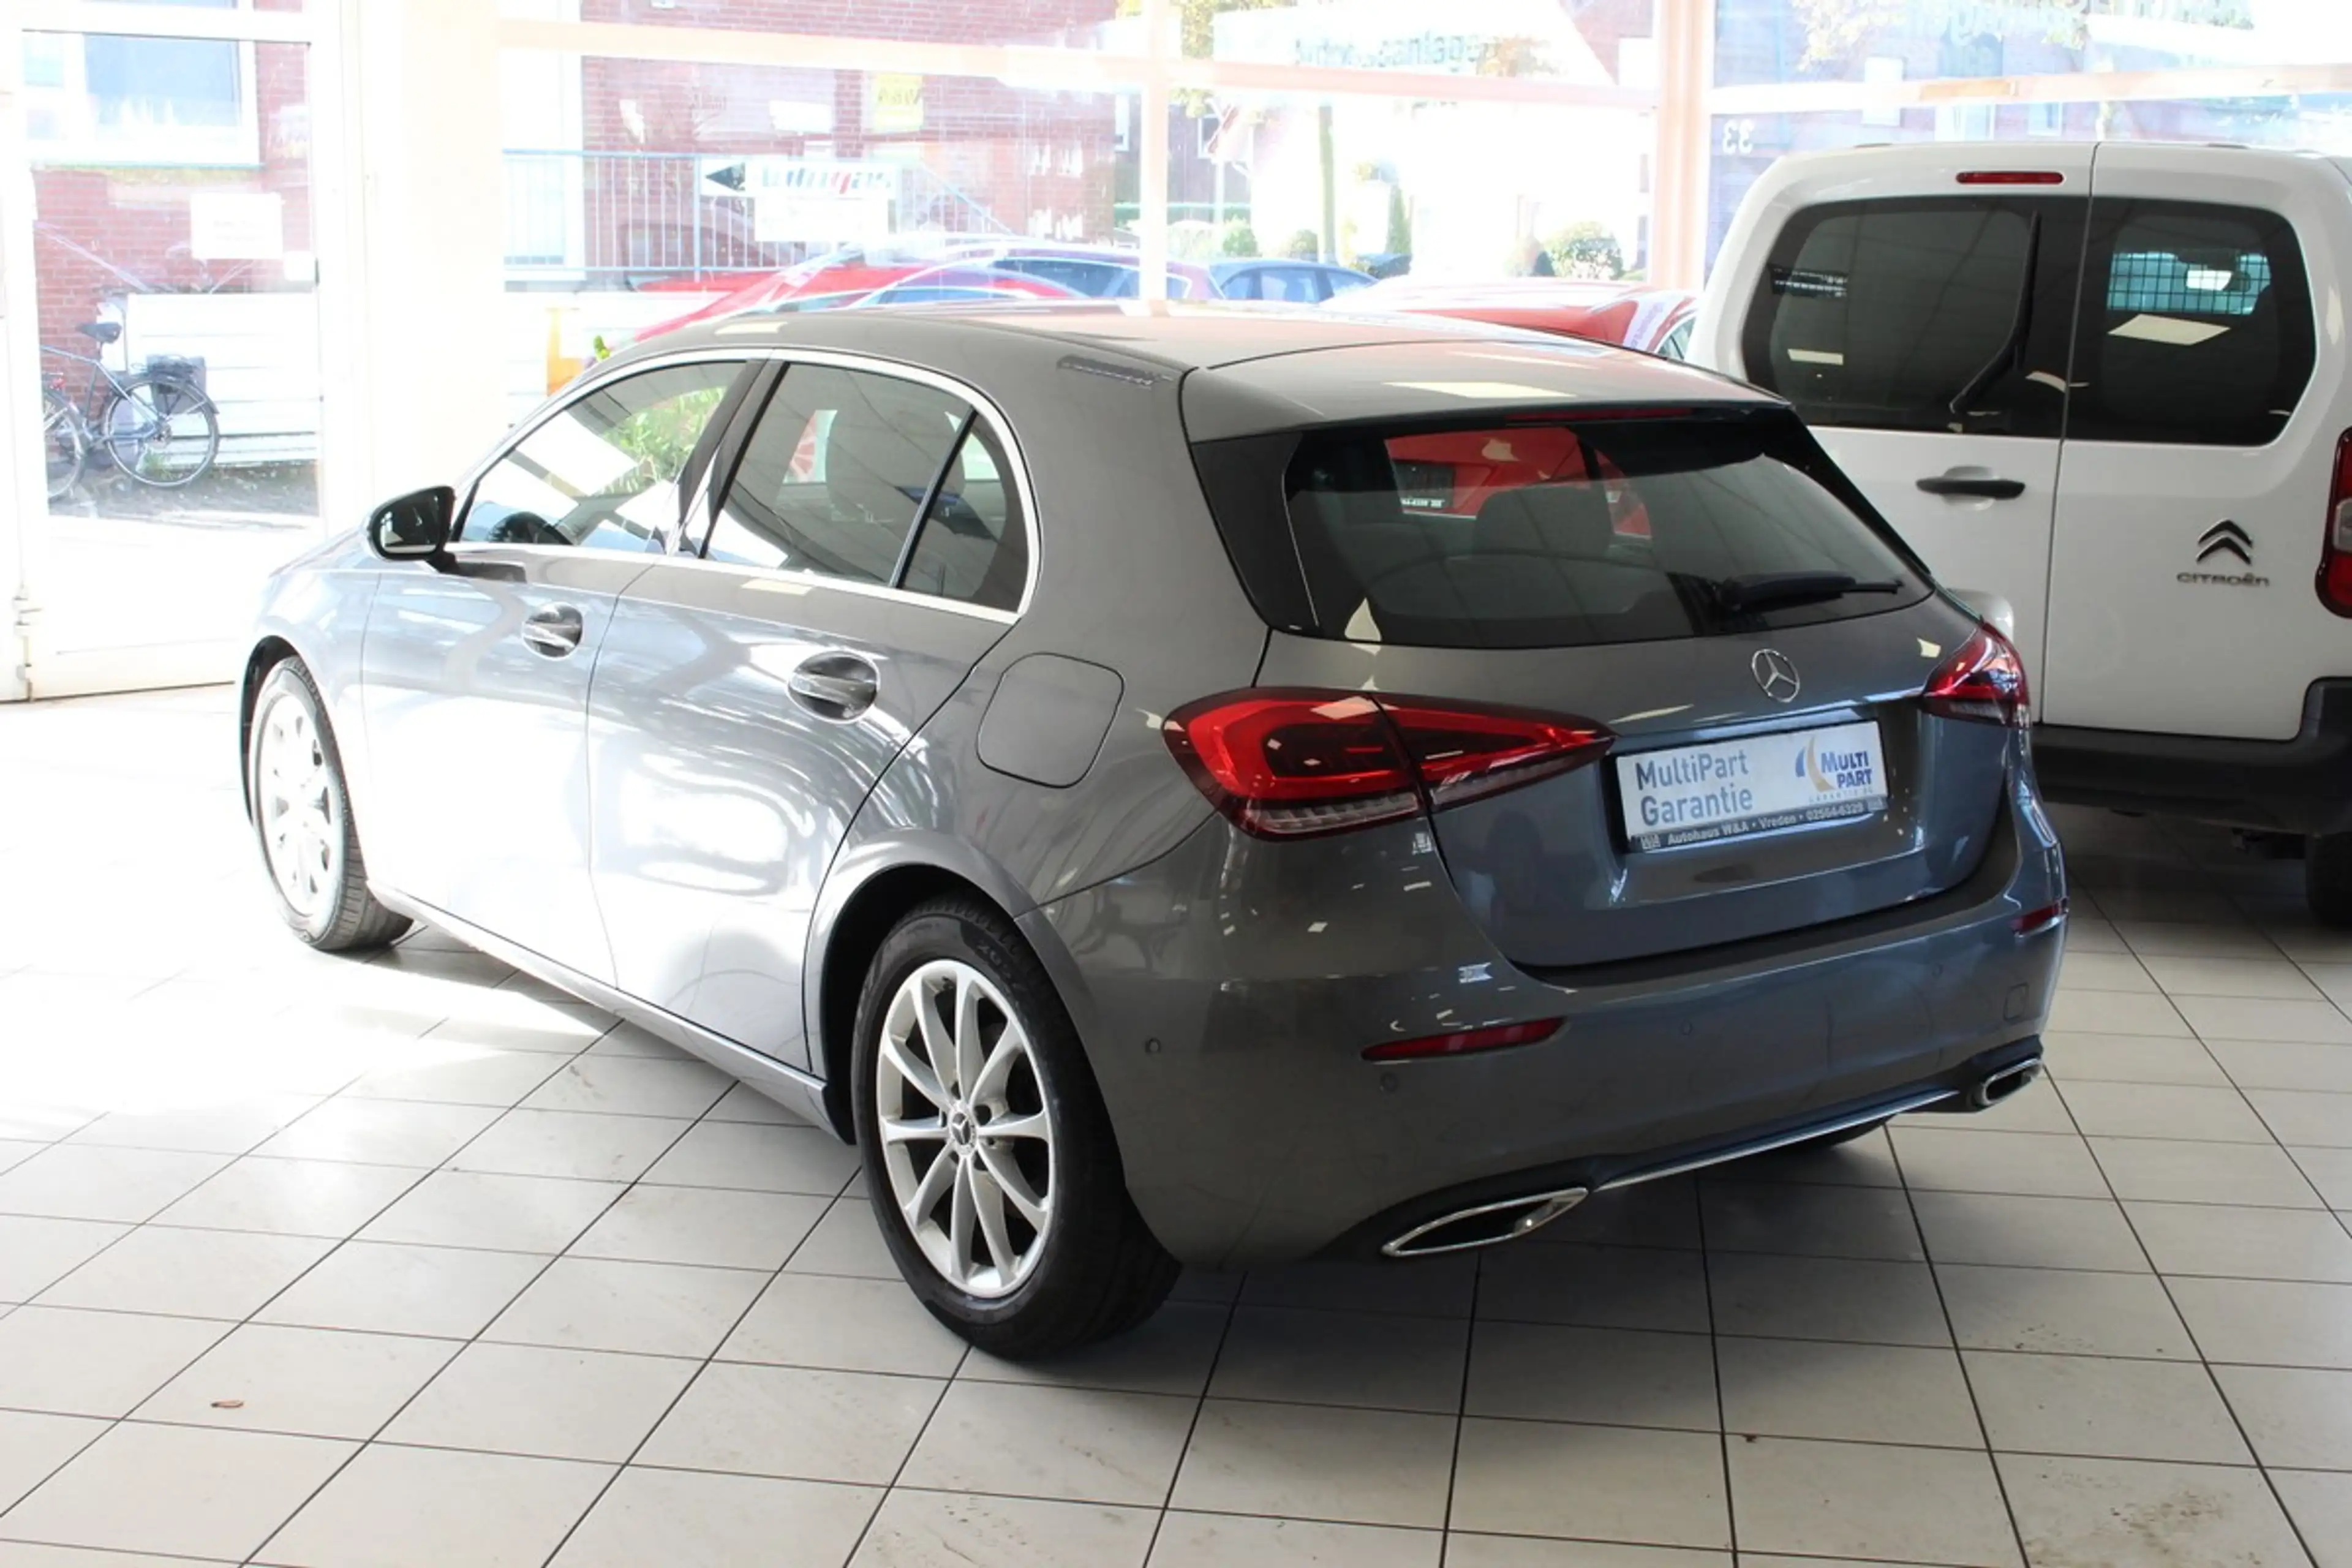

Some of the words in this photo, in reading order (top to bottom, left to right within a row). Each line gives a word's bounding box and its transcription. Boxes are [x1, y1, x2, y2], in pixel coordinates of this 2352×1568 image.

[1635, 750, 1749, 791] MultiPart
[1836, 768, 1872, 789] PART
[1640, 782, 1753, 826] Garantie
[1667, 828, 1720, 846] Autohaus
[1757, 815, 1797, 829] Vreden
